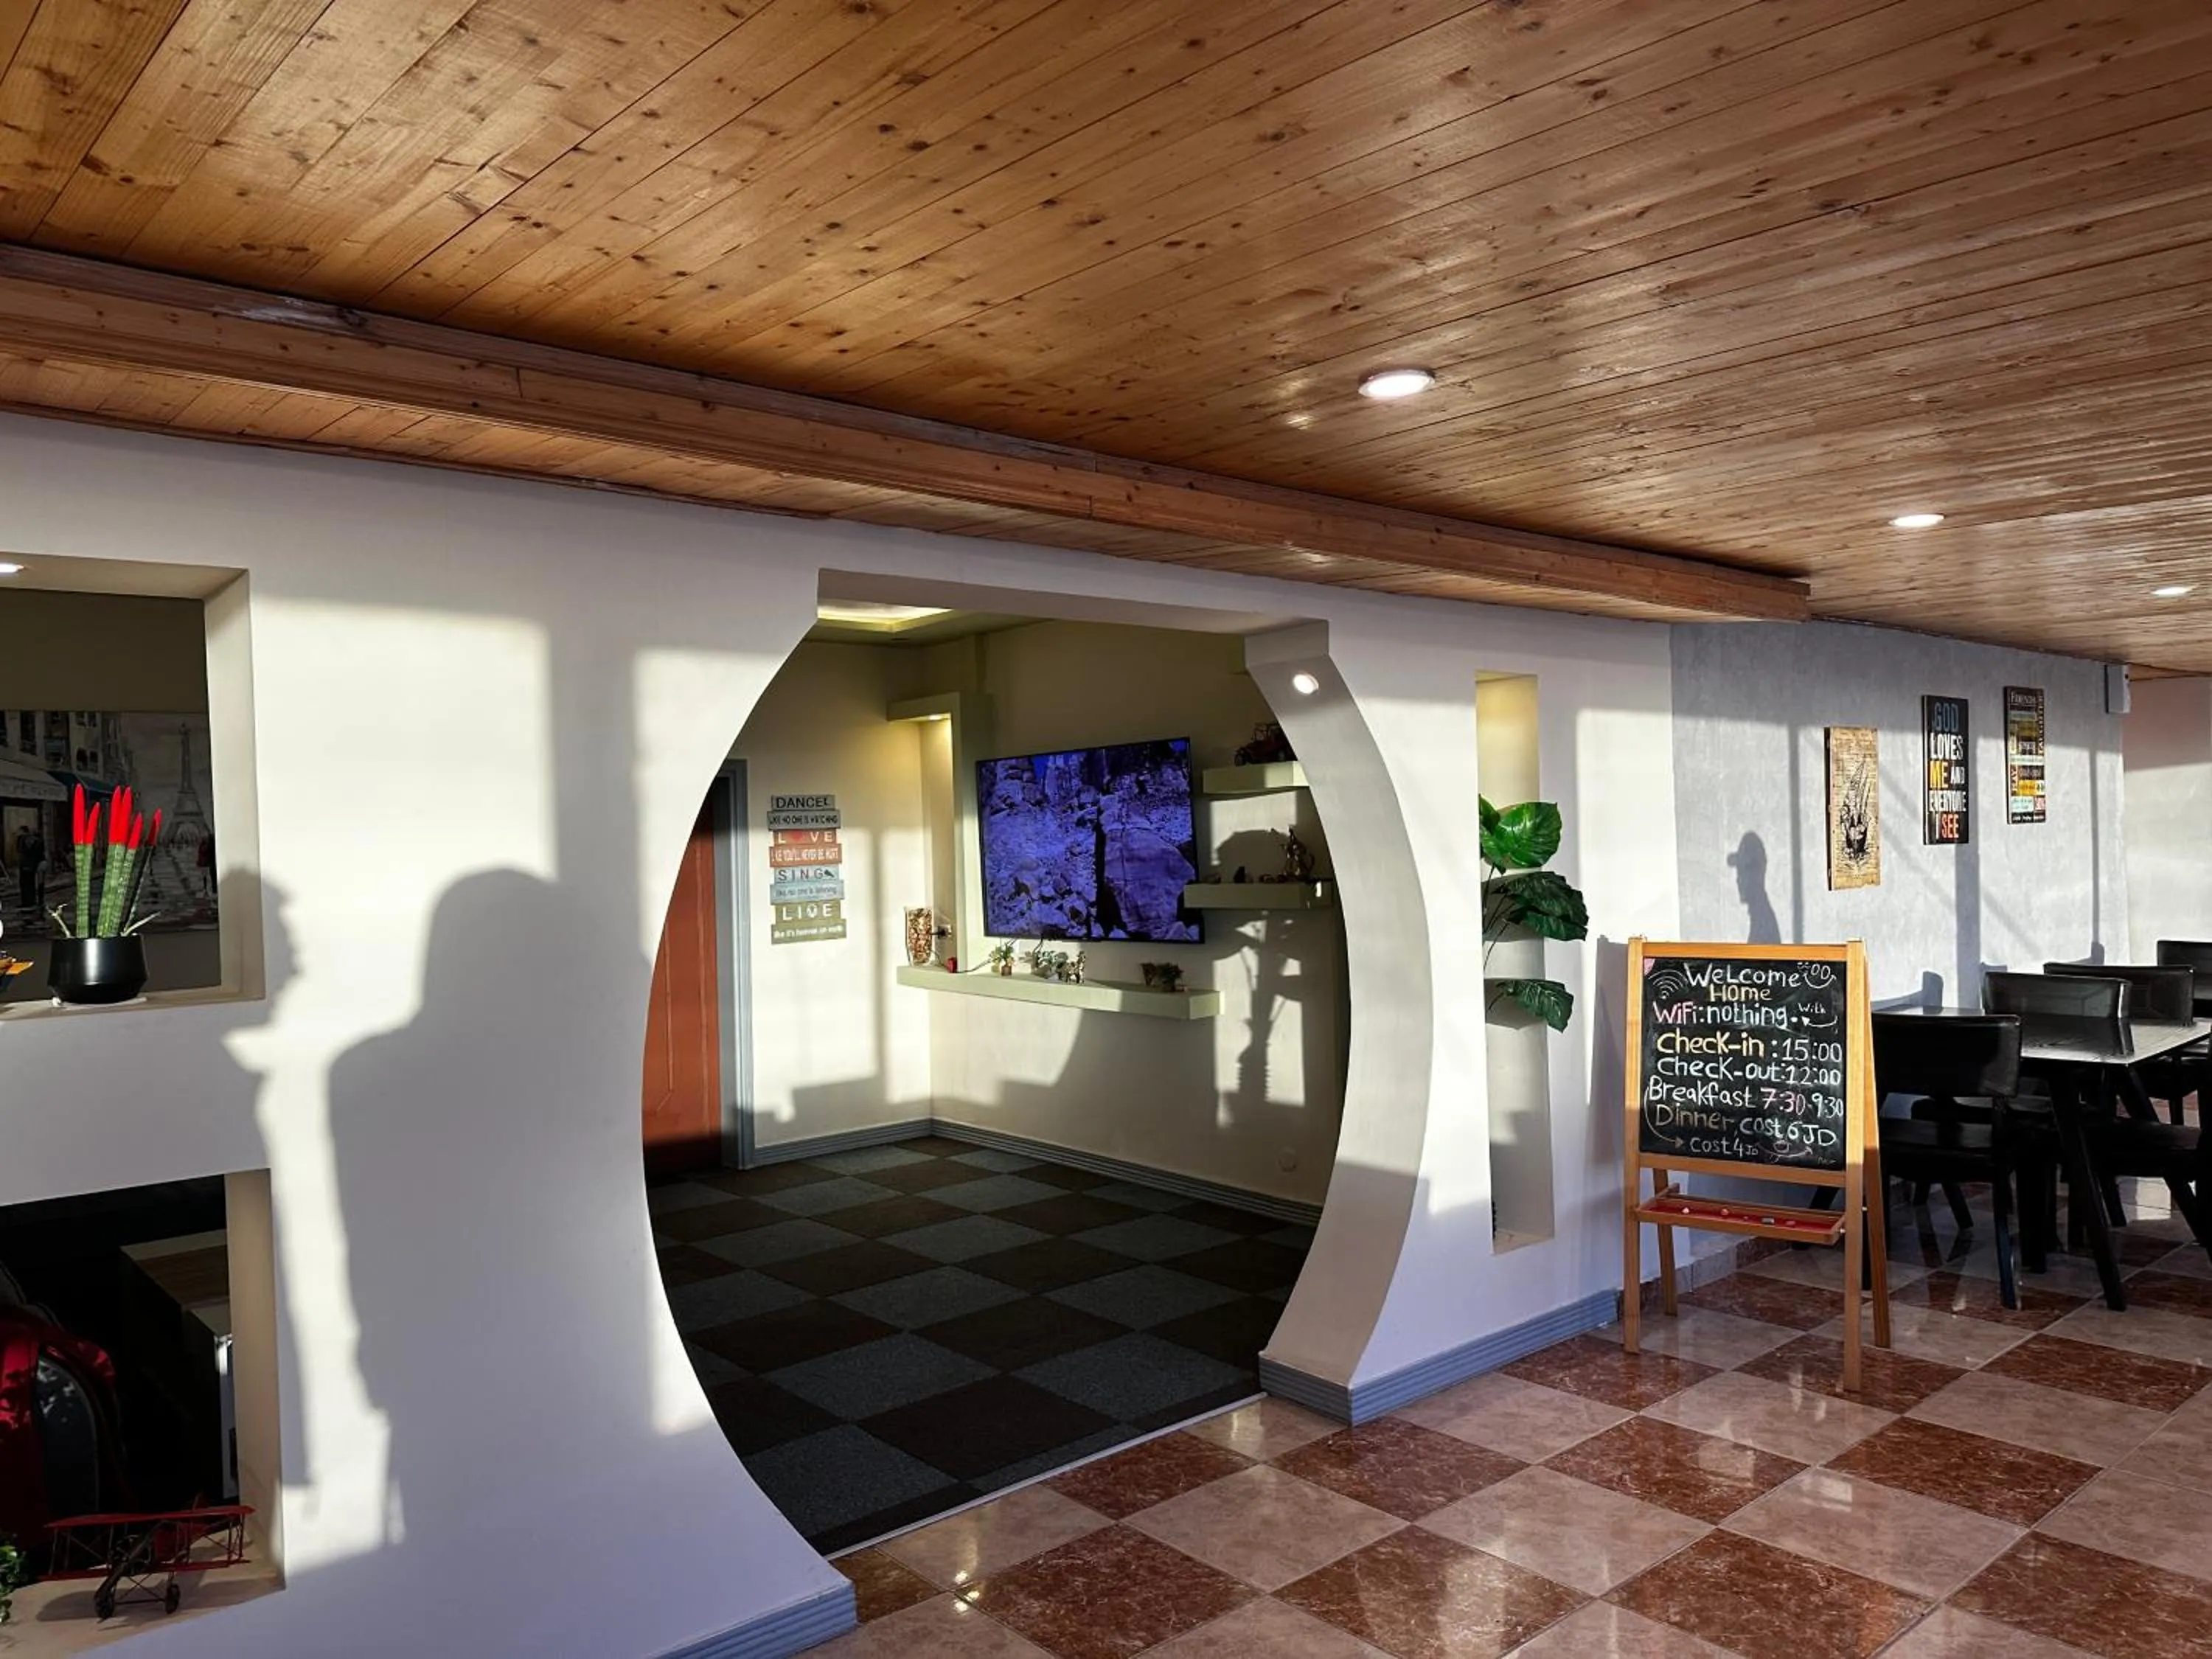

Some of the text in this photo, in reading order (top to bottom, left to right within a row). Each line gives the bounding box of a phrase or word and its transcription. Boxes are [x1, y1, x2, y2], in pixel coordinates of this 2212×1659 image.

[1933, 702, 1959, 732] GOD
[1930, 732, 1964, 760] LOVES
[1930, 760, 1965, 788] ME AND
[1929, 790, 1967, 812] EVERYONE
[1935, 813, 1959, 839] I SEE
[778, 869, 824, 882] SING
[1649, 1074, 1756, 1108] Breakfast
